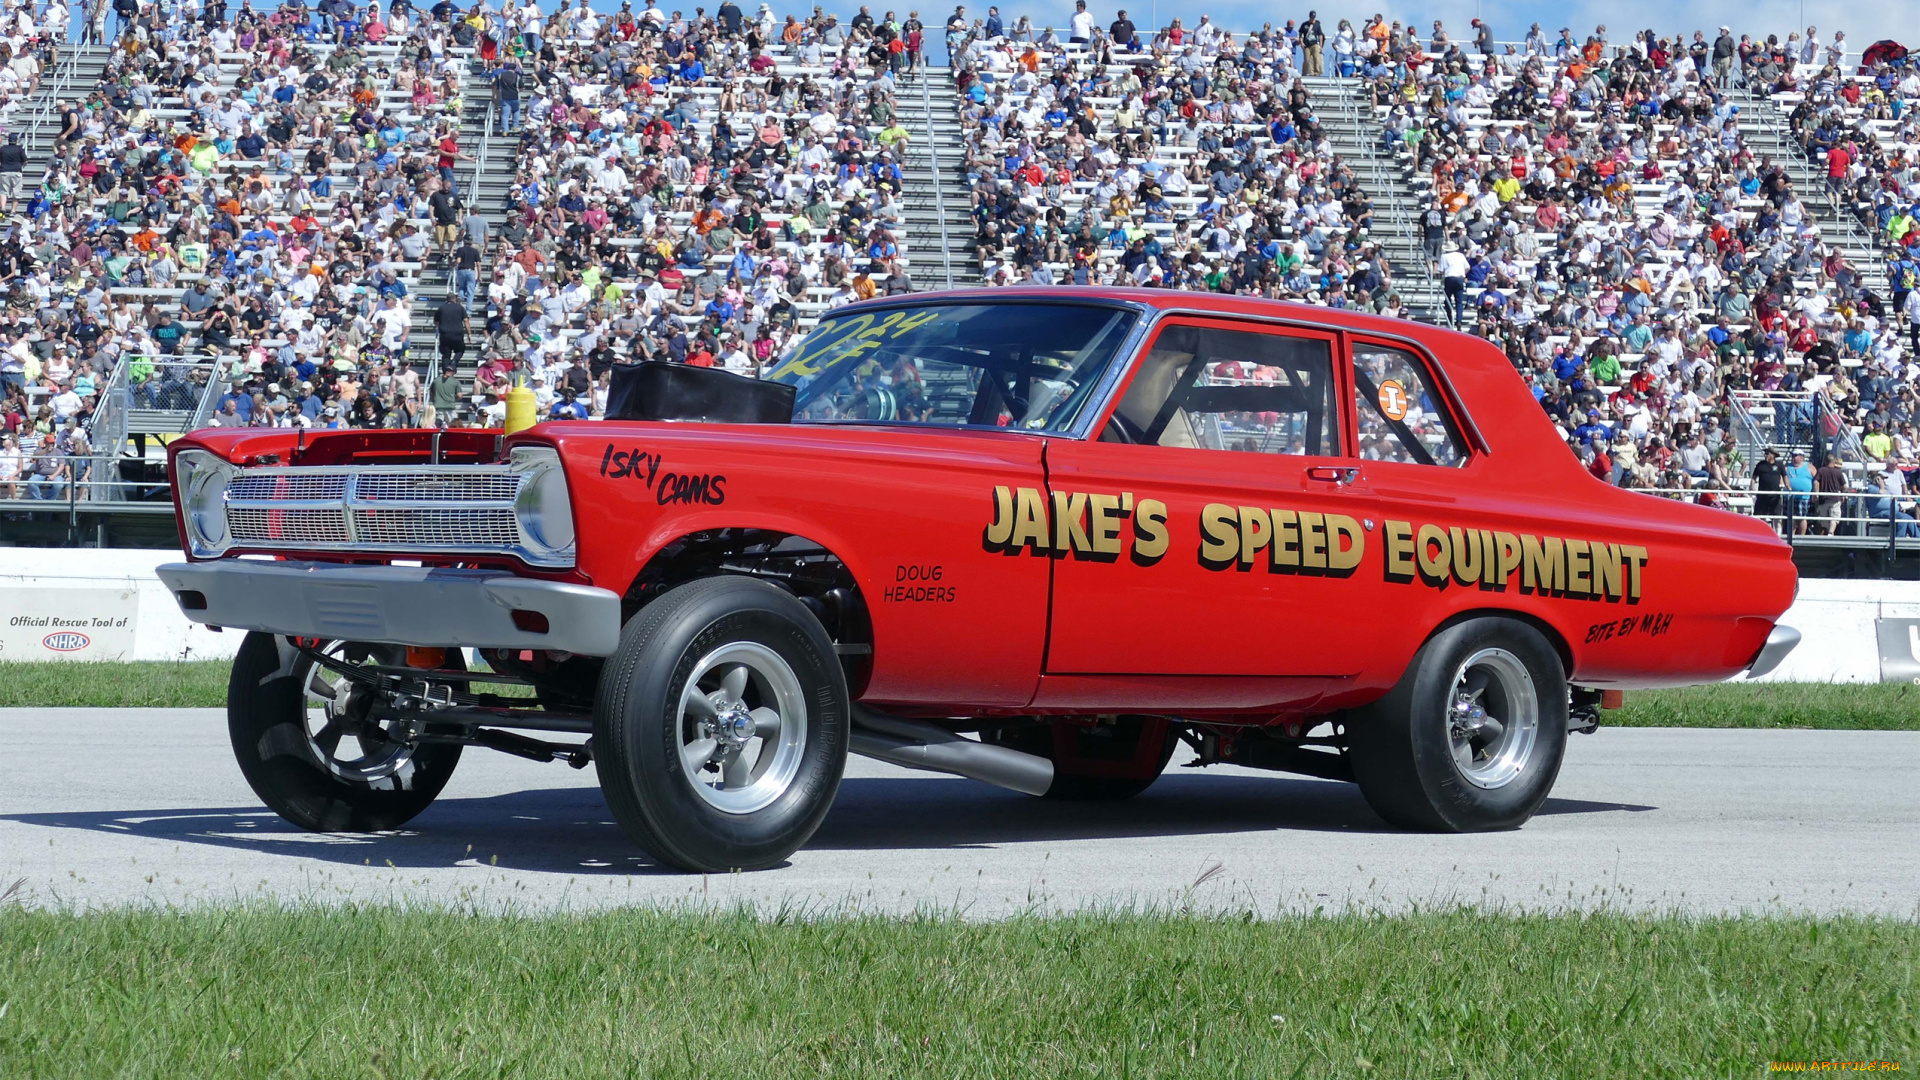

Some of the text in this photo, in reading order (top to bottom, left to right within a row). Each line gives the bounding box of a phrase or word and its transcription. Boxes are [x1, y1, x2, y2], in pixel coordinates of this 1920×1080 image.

[600, 443, 726, 505] ISKY CAMS
[982, 485, 1649, 605] JAKE'S SPEED EQUIPMENT
[896, 565, 943, 582] DOUG
[883, 586, 956, 603] HEADERS
[10, 616, 128, 627] Official Rescue Tool of
[1585, 612, 1674, 644] BITE BY M&H
[49, 634, 84, 649] NHRA
